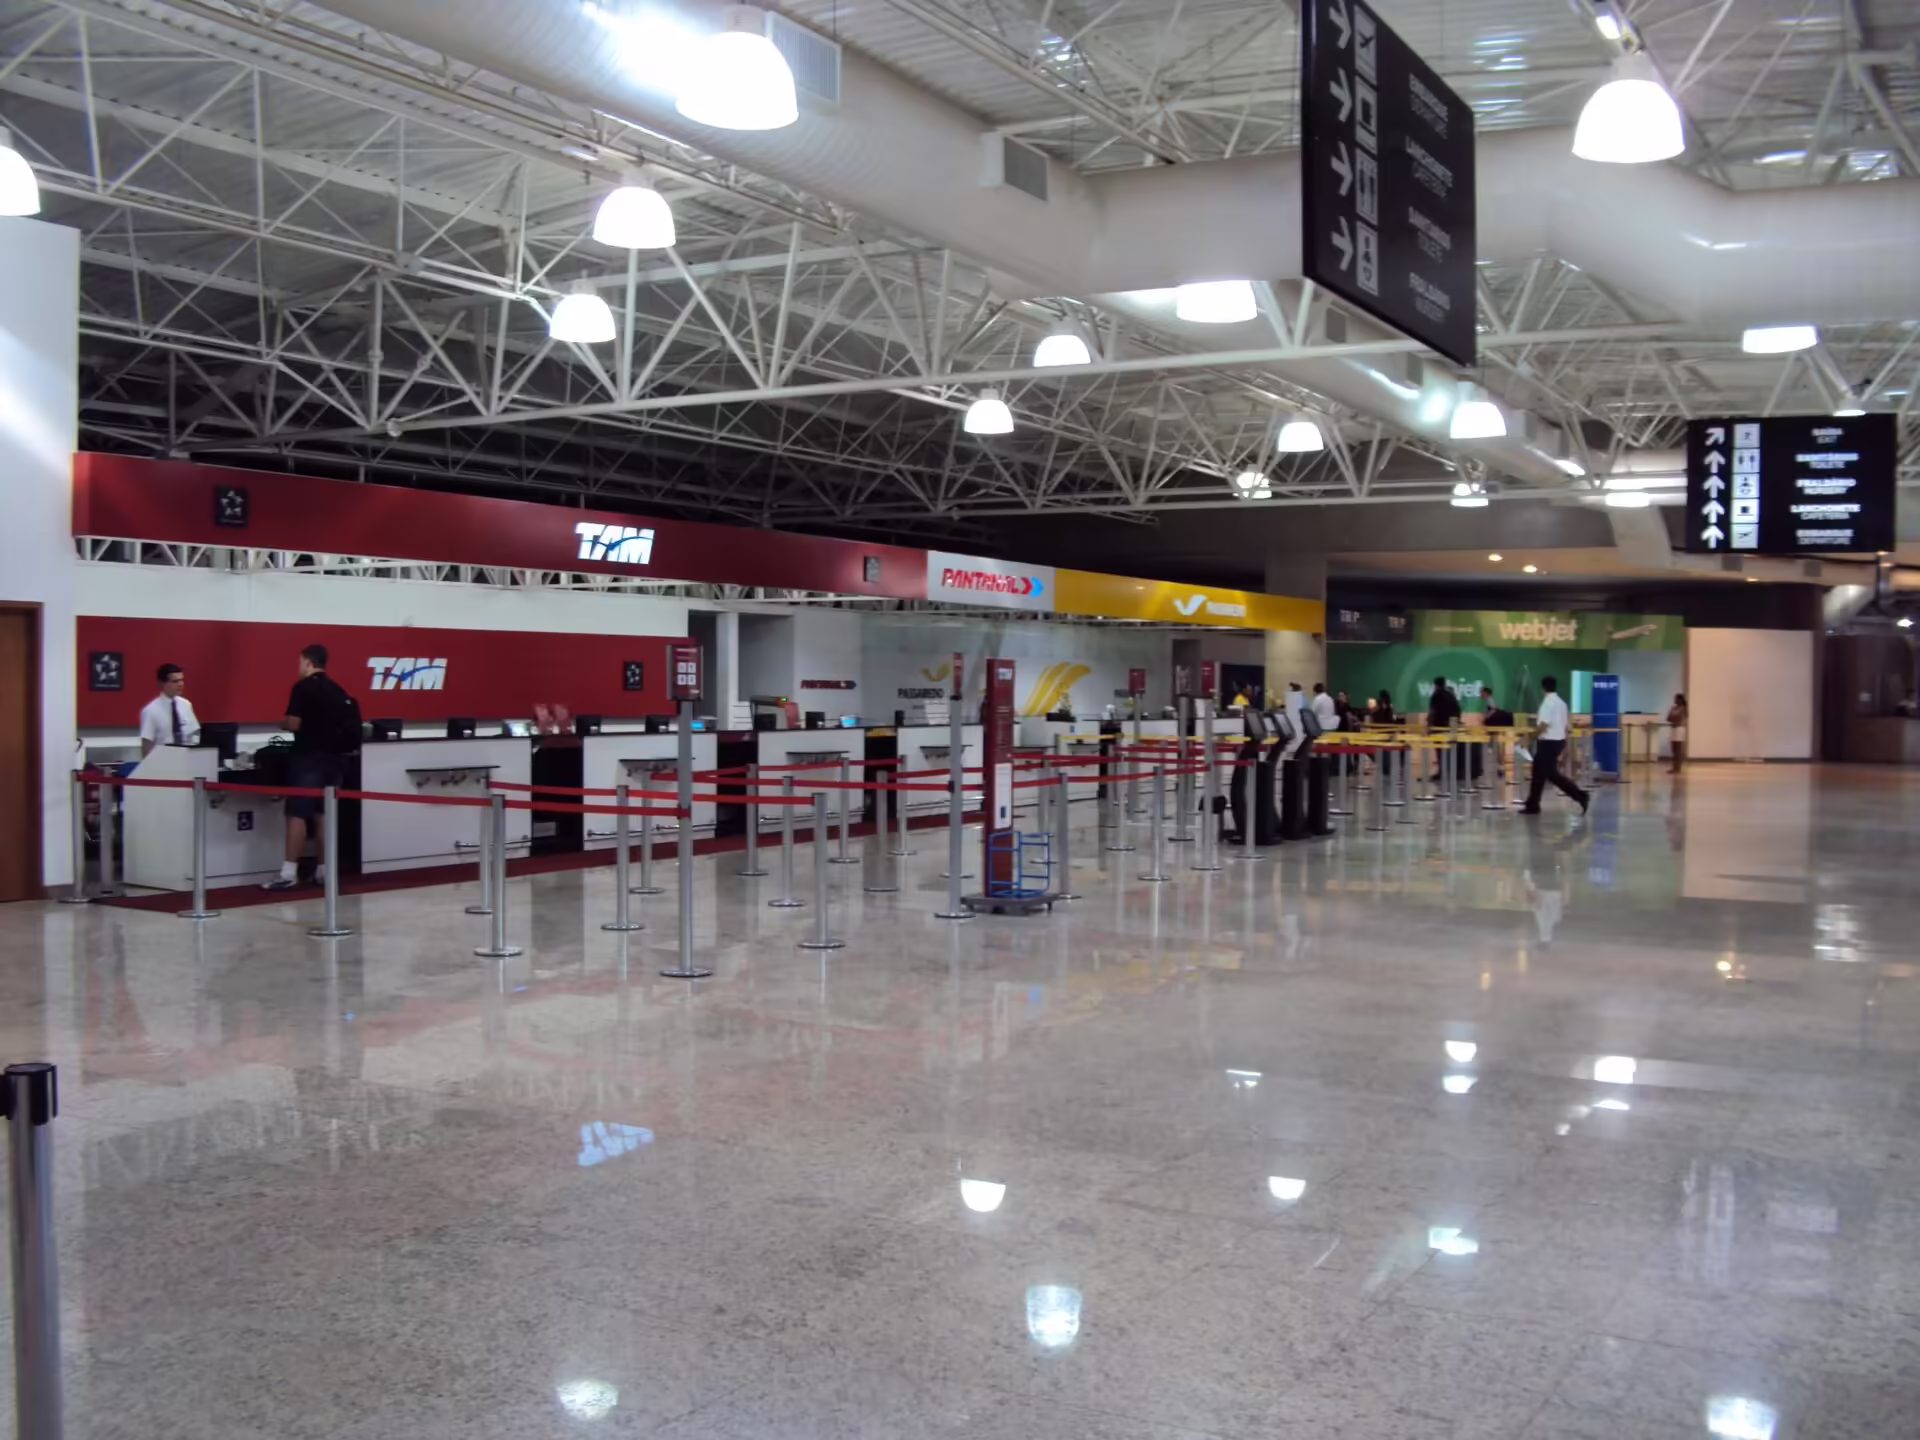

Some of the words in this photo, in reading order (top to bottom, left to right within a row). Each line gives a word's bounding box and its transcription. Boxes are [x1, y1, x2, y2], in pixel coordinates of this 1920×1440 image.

[575, 522, 655, 564] TAM
[941, 567, 1020, 595] PANTANAL
[1499, 617, 1578, 645] webjet
[367, 657, 448, 690] TAM
